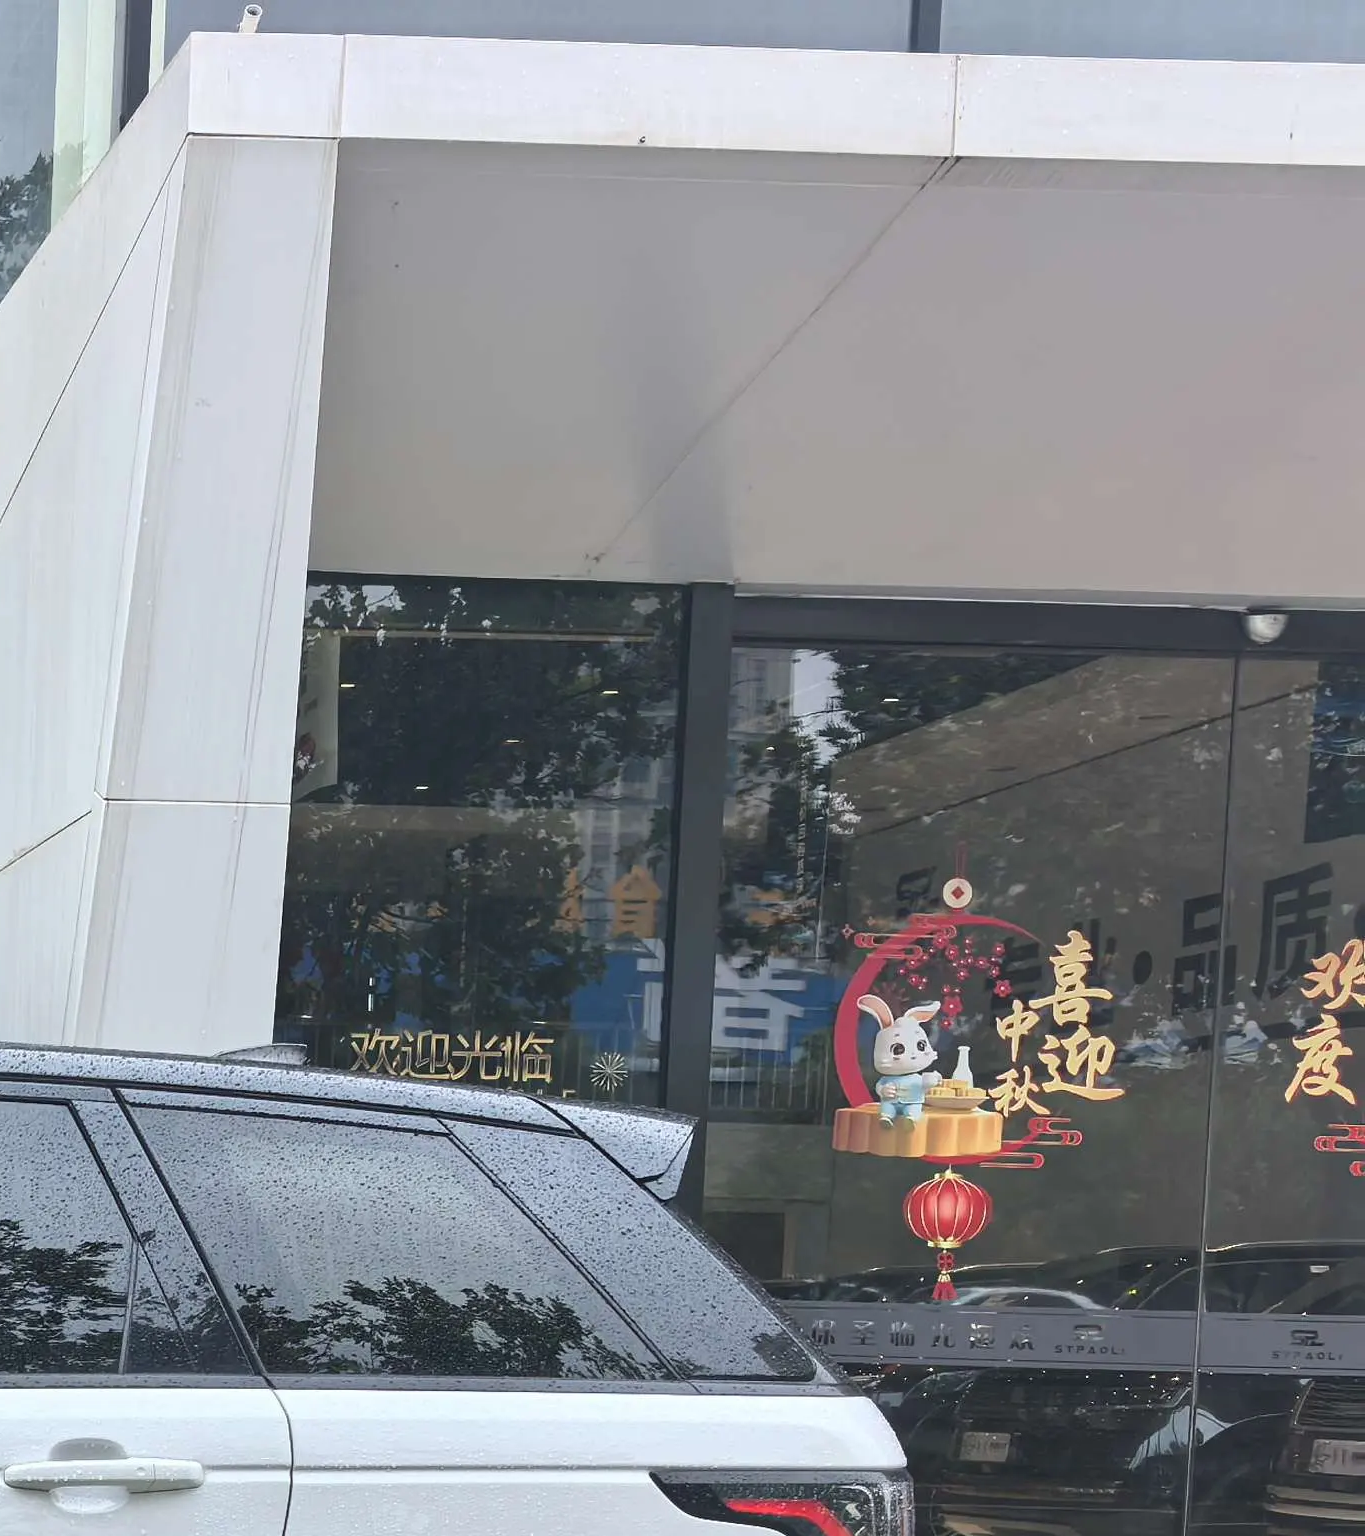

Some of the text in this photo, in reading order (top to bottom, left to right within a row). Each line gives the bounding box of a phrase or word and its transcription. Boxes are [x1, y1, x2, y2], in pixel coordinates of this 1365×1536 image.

[350, 1028, 555, 1083] 欢迎光临
[987, 999, 1051, 1118] 中秋
[1028, 930, 1126, 1101] 喜迎
[1284, 938, 1365, 1105] 欢度
